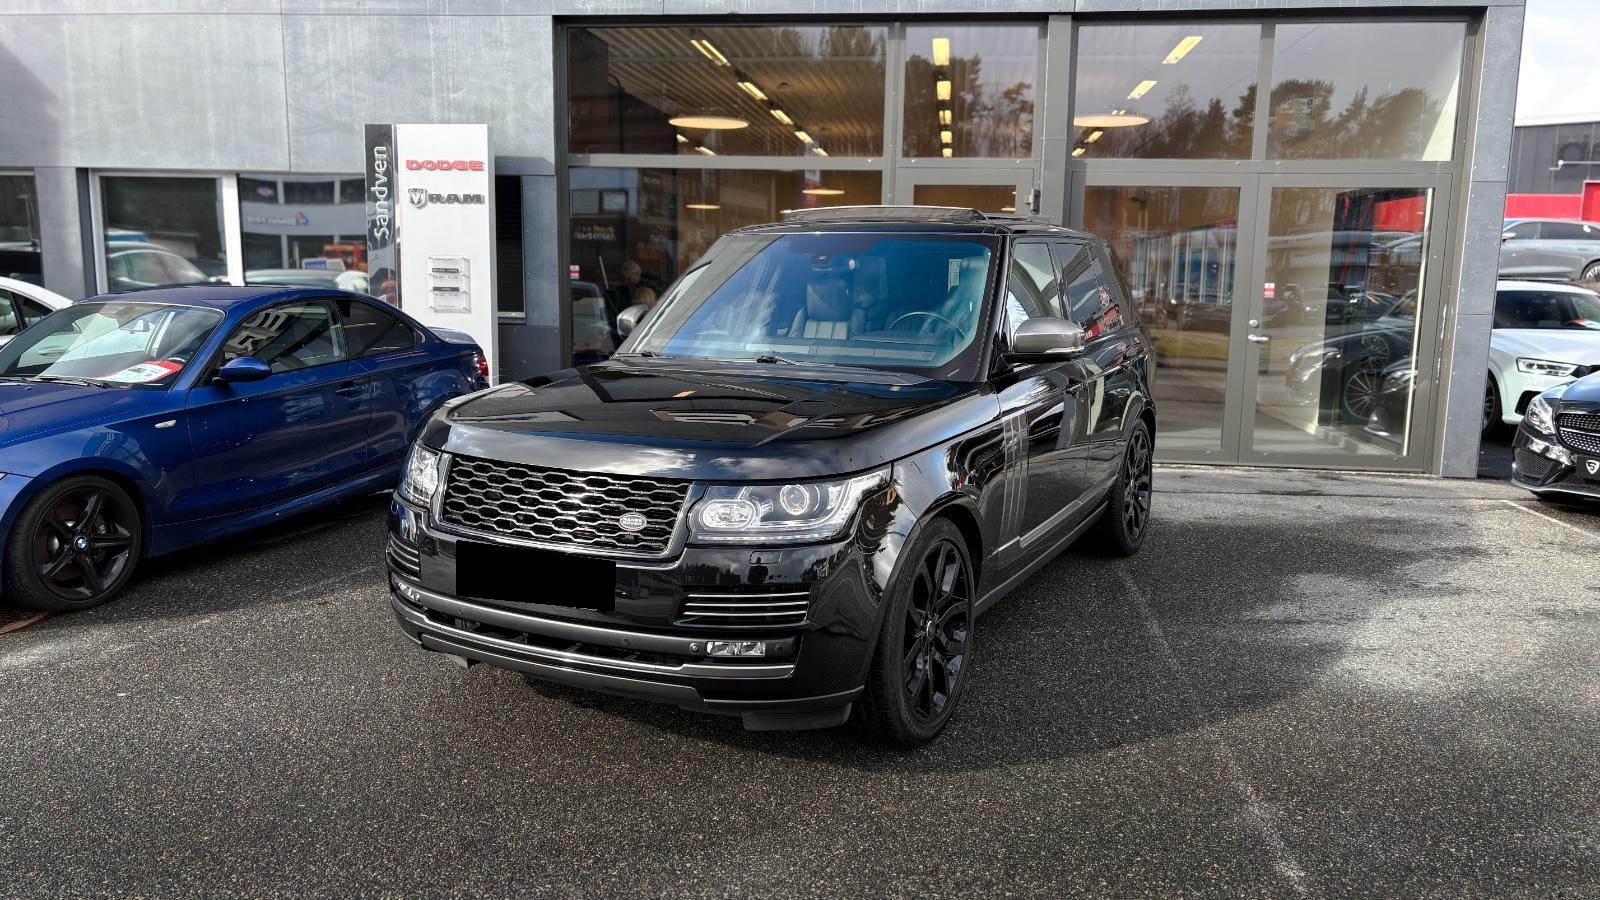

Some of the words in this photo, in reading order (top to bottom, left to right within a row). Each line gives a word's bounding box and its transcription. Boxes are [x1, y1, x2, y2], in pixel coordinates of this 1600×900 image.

[406, 160, 485, 171] DODGE
[371, 146, 389, 240] Sandven
[429, 193, 485, 204] RAM
